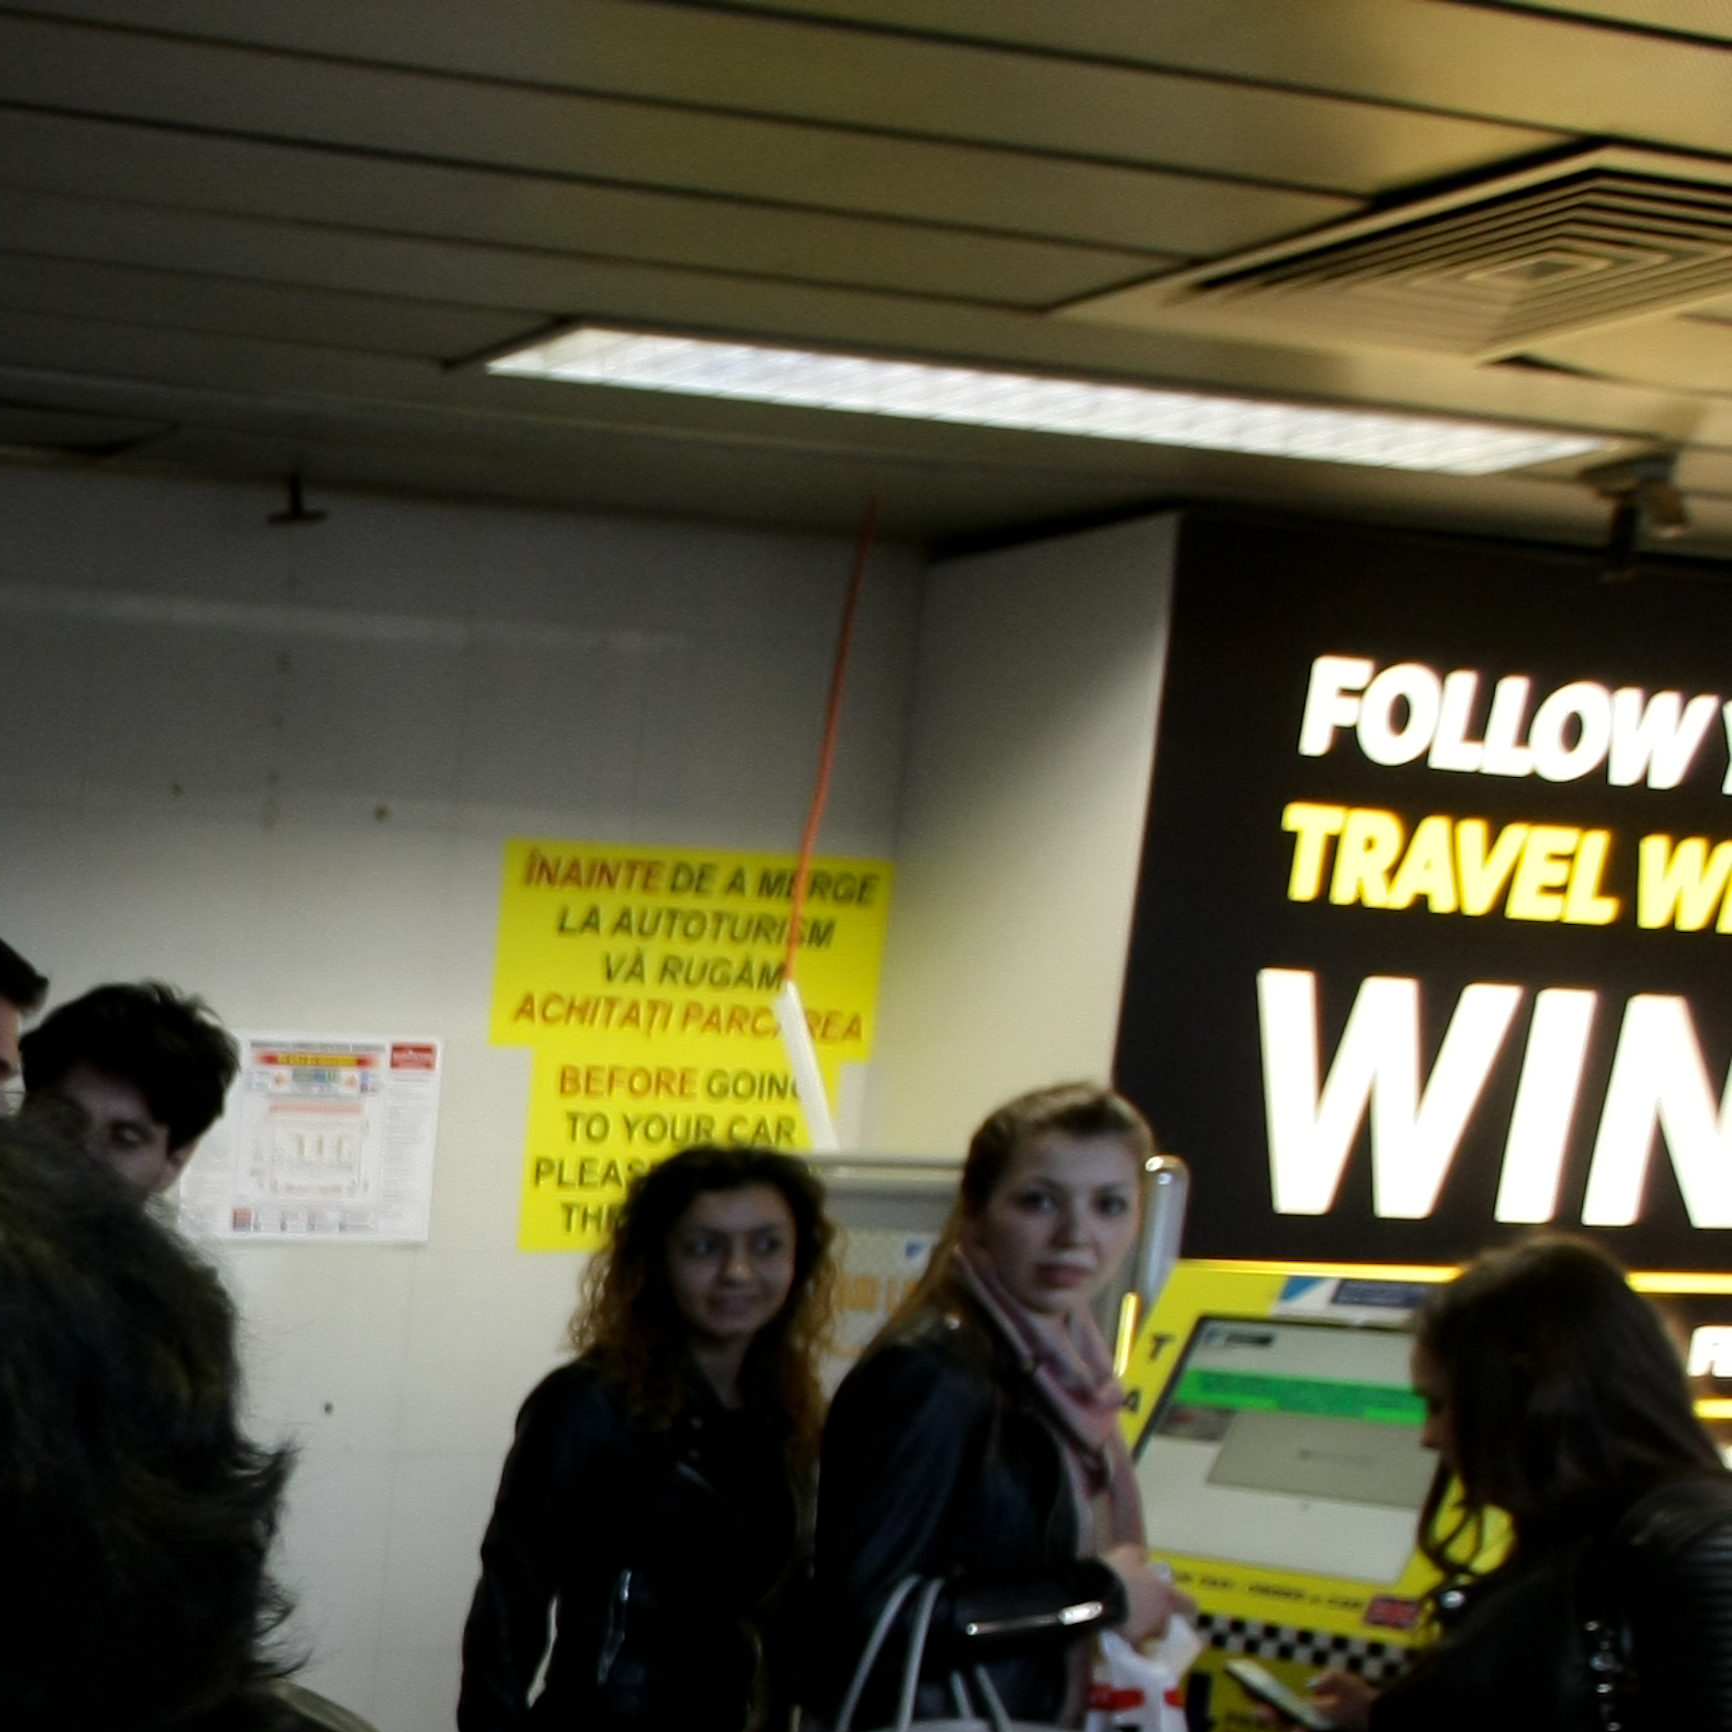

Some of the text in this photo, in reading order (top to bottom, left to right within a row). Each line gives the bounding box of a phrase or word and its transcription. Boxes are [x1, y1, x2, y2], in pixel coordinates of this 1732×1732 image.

[1298, 654, 1719, 790] FOLLOW
[525, 847, 666, 891] ÎNAINTE
[670, 862, 716, 895] DE
[724, 866, 748, 896] A
[1281, 802, 1619, 926] TRAVEL
[556, 905, 601, 937] LA
[680, 1001, 864, 1042] PARCREA
[559, 1065, 800, 1101] BEFORE GOIN
[566, 1111, 796, 1146] TO YOUR CAR
[534, 1156, 652, 1188] PLEAS
